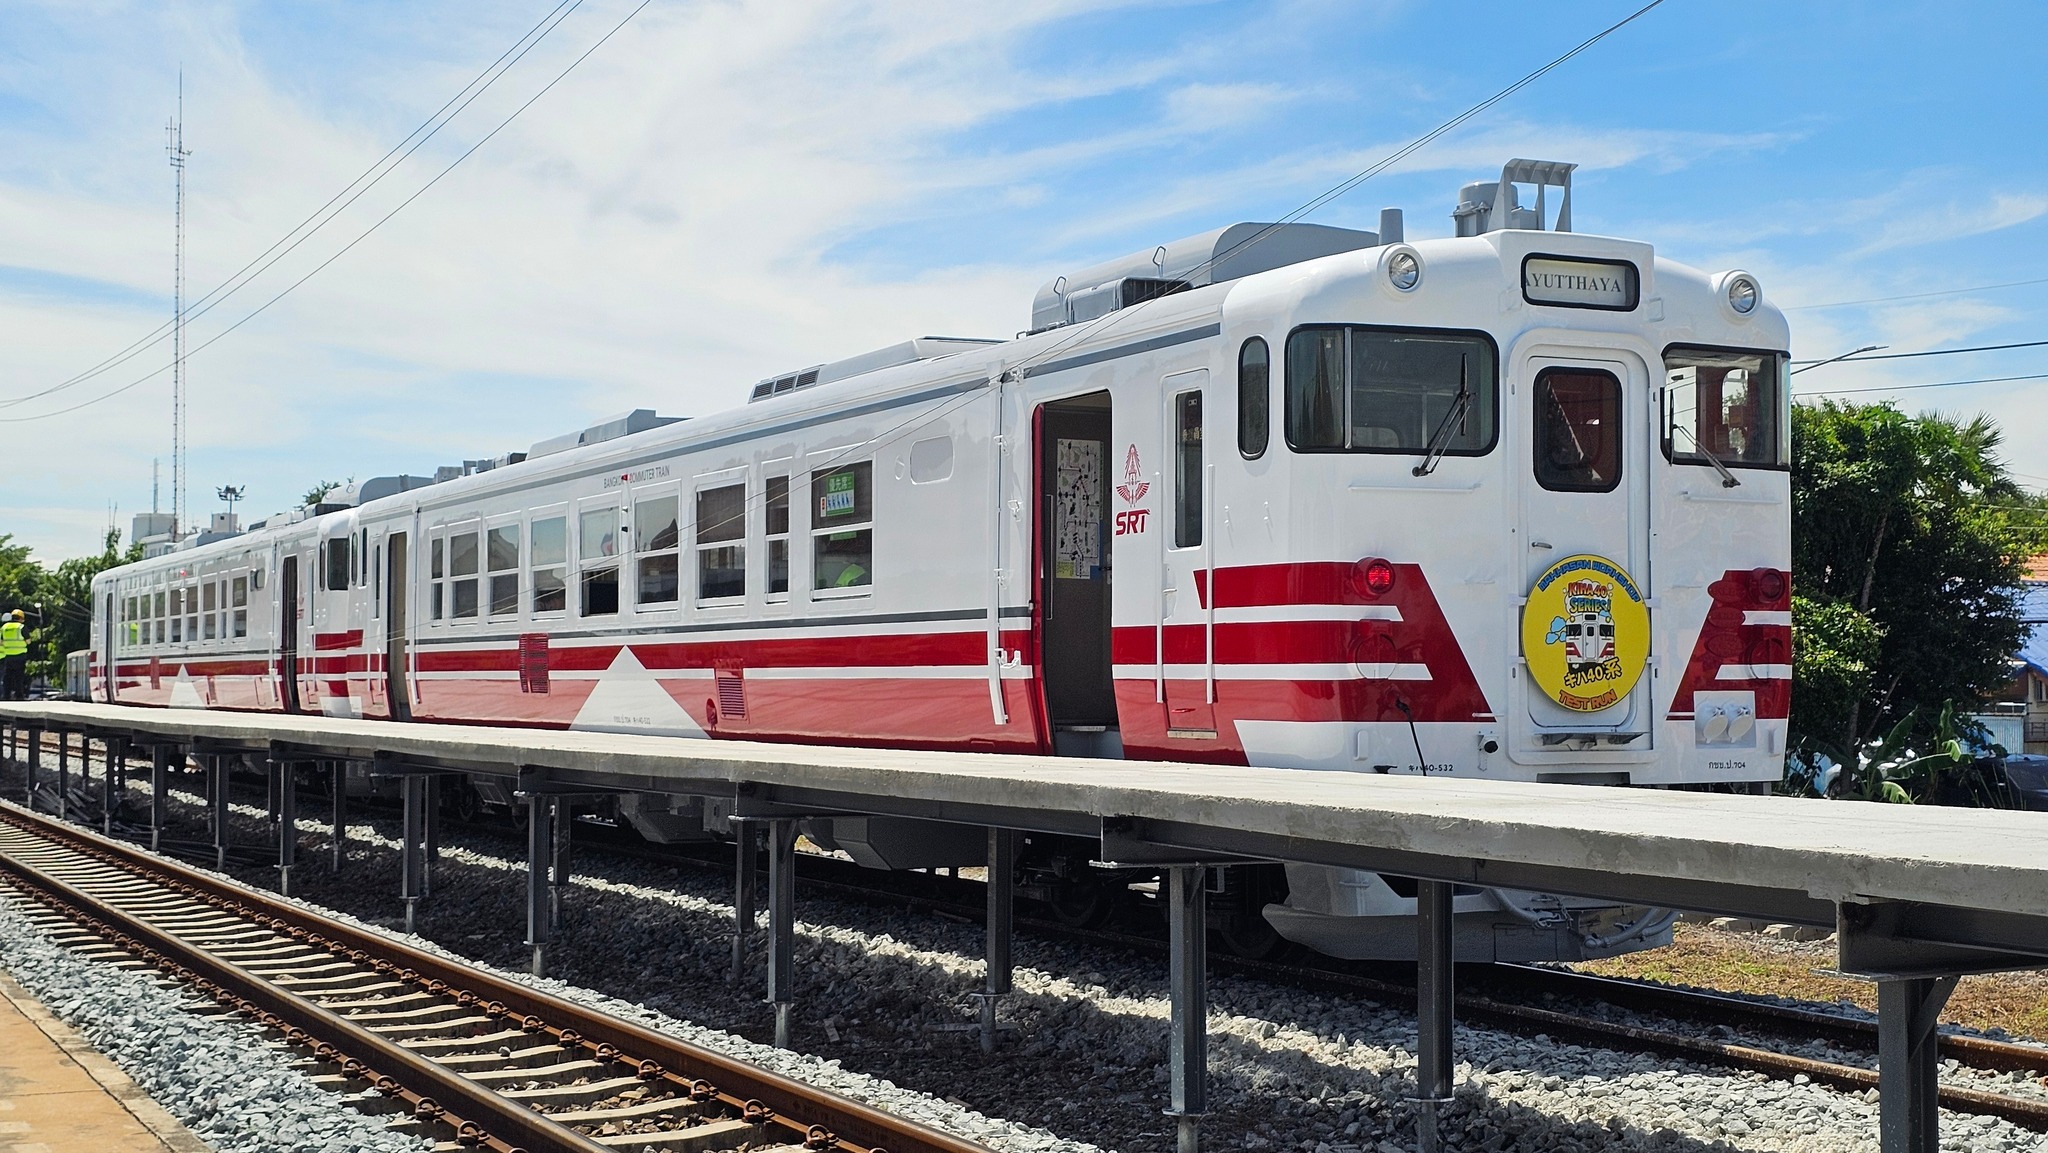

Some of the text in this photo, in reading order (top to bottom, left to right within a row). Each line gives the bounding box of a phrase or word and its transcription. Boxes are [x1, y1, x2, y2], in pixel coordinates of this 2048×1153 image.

[629, 467, 654, 483] COMMUTER
[655, 465, 670, 478] TRAIN
[1116, 509, 1150, 535] SRT
[1537, 560, 1641, 602] MAKHASAN WORKSHOP
[1568, 581, 1609, 598] KIHA 40
[1564, 656, 1623, 688] キハ40系
[1559, 688, 1618, 710] TEST RUN
